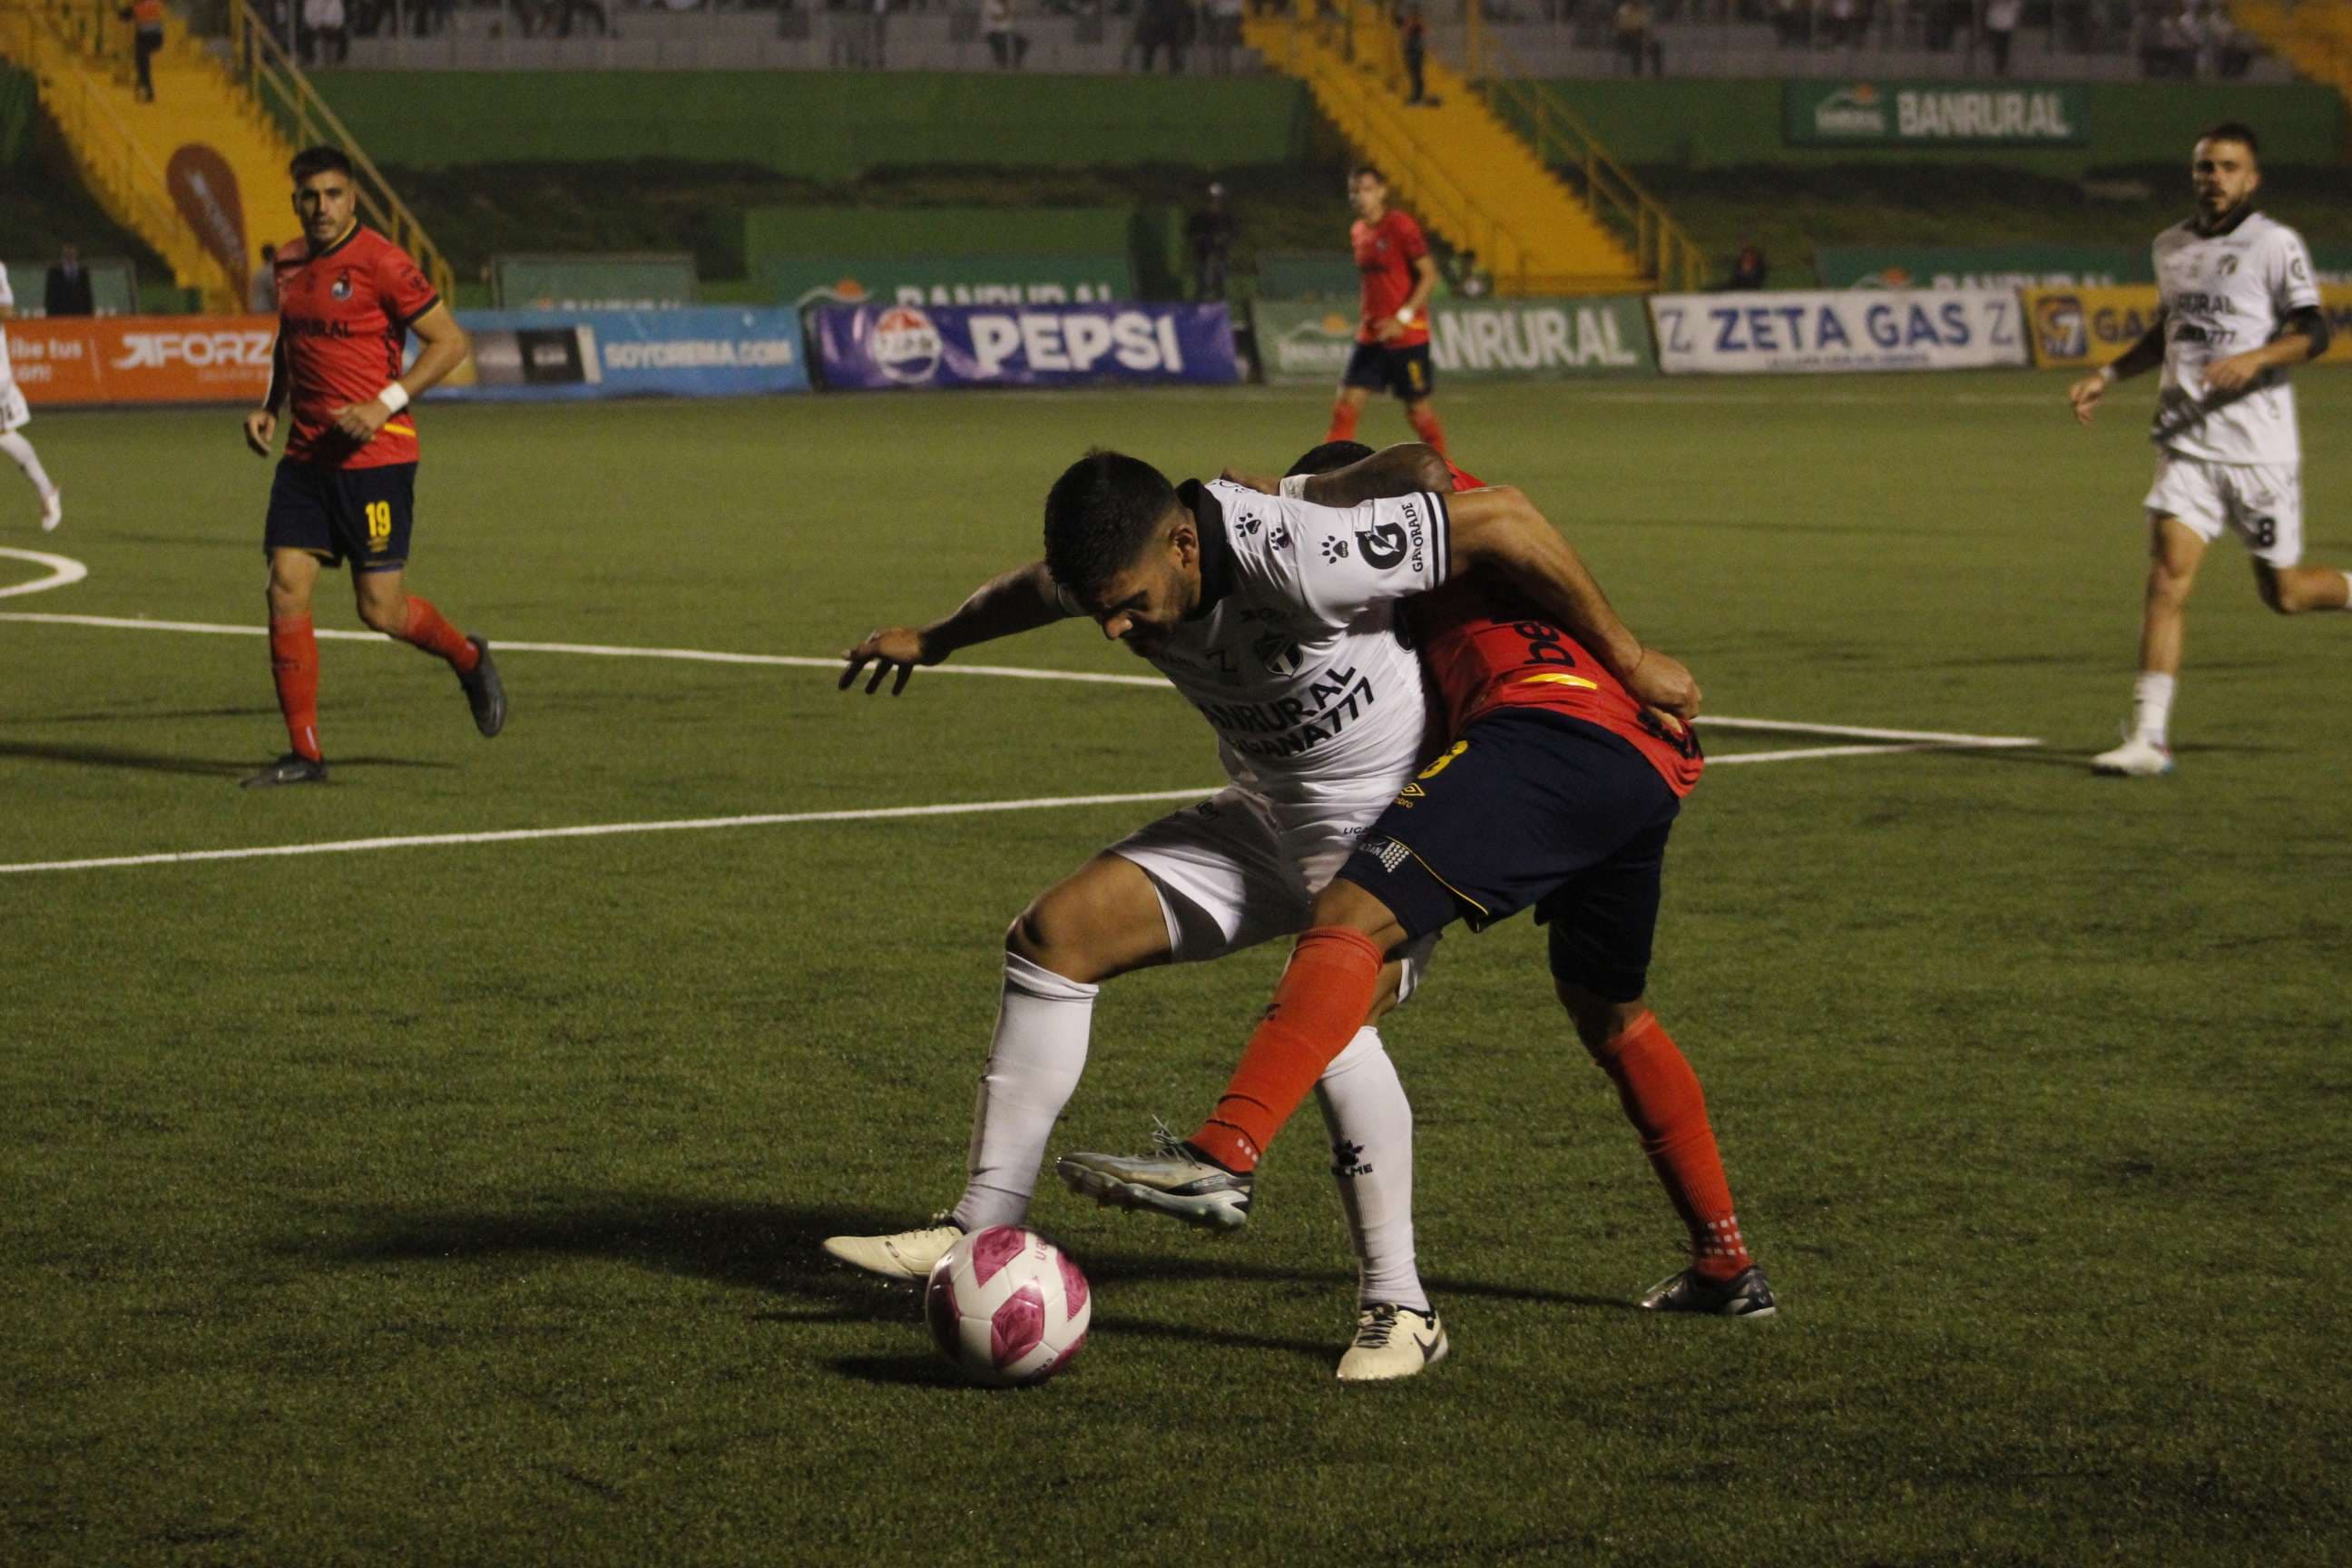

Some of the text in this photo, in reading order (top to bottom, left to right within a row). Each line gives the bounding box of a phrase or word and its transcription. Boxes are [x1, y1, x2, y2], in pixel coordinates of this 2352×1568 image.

[1897, 92, 2073, 135] BANRURAL
[967, 311, 1185, 373] PEPSI
[1661, 301, 2014, 353] Z ZETA GAS Z
[365, 500, 391, 538] 19
